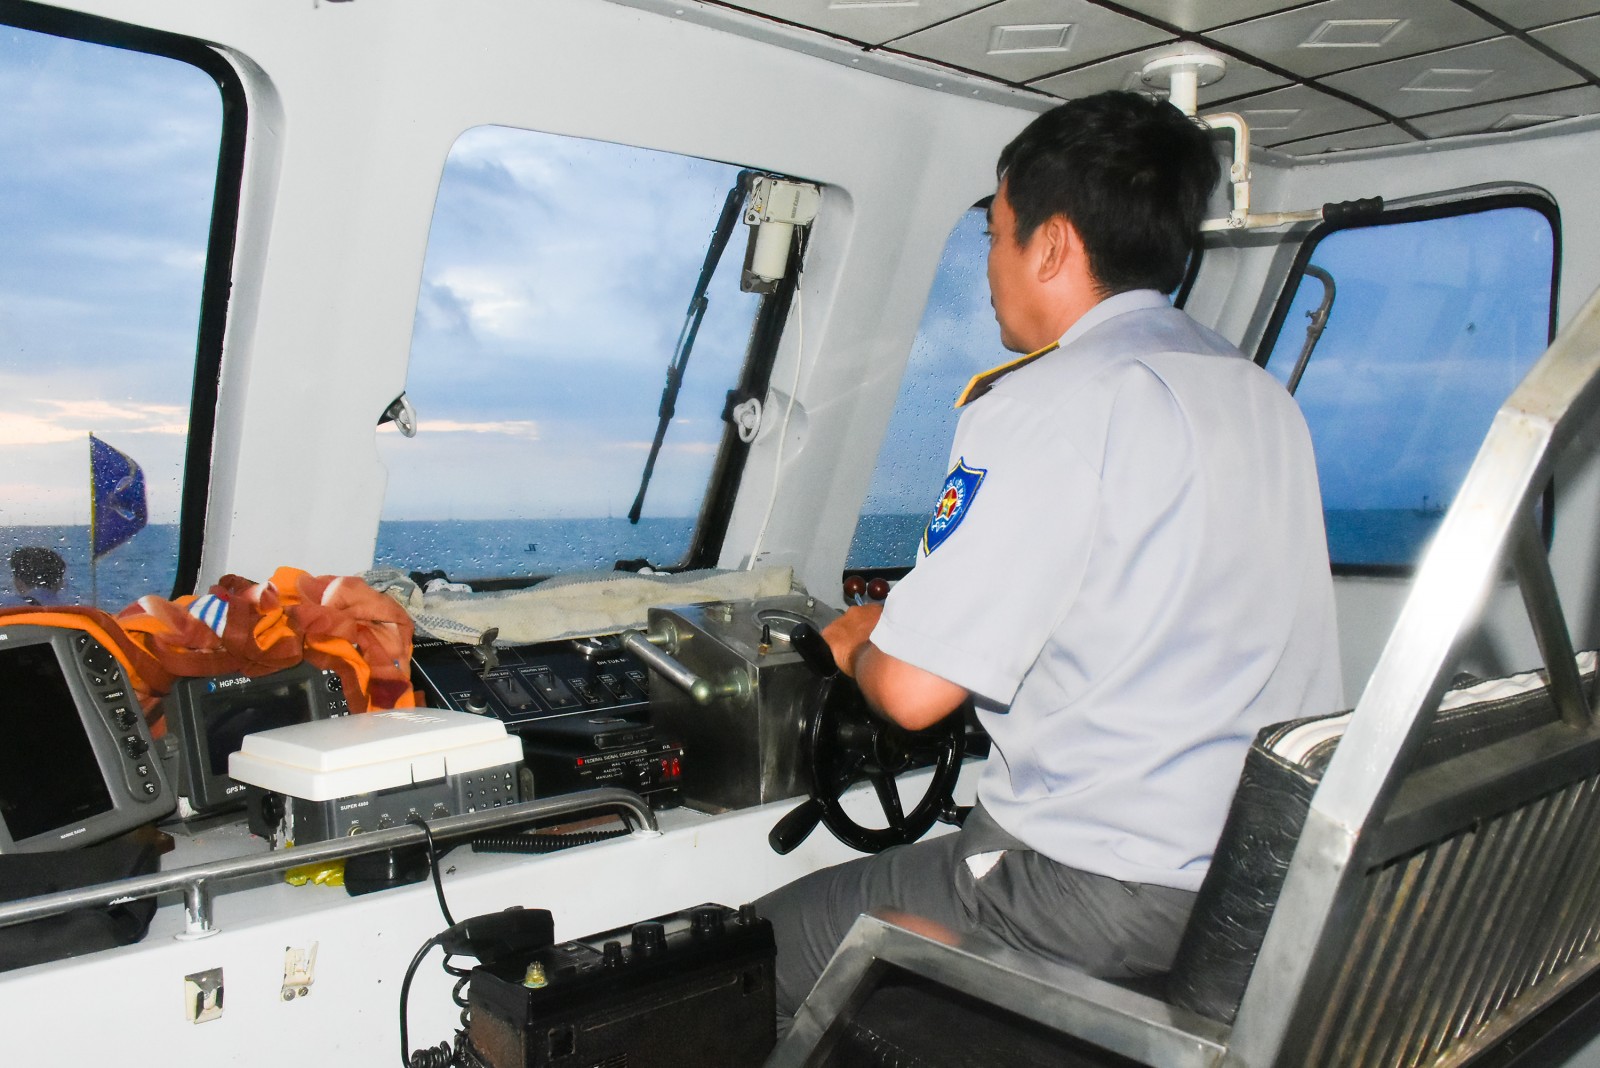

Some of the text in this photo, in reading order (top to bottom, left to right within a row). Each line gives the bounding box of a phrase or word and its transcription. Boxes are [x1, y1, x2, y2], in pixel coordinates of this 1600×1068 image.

[603, 753, 619, 761] SIGNAL
[619, 749, 648, 758] CORPORATION
[340, 803, 358, 811] SUPER
